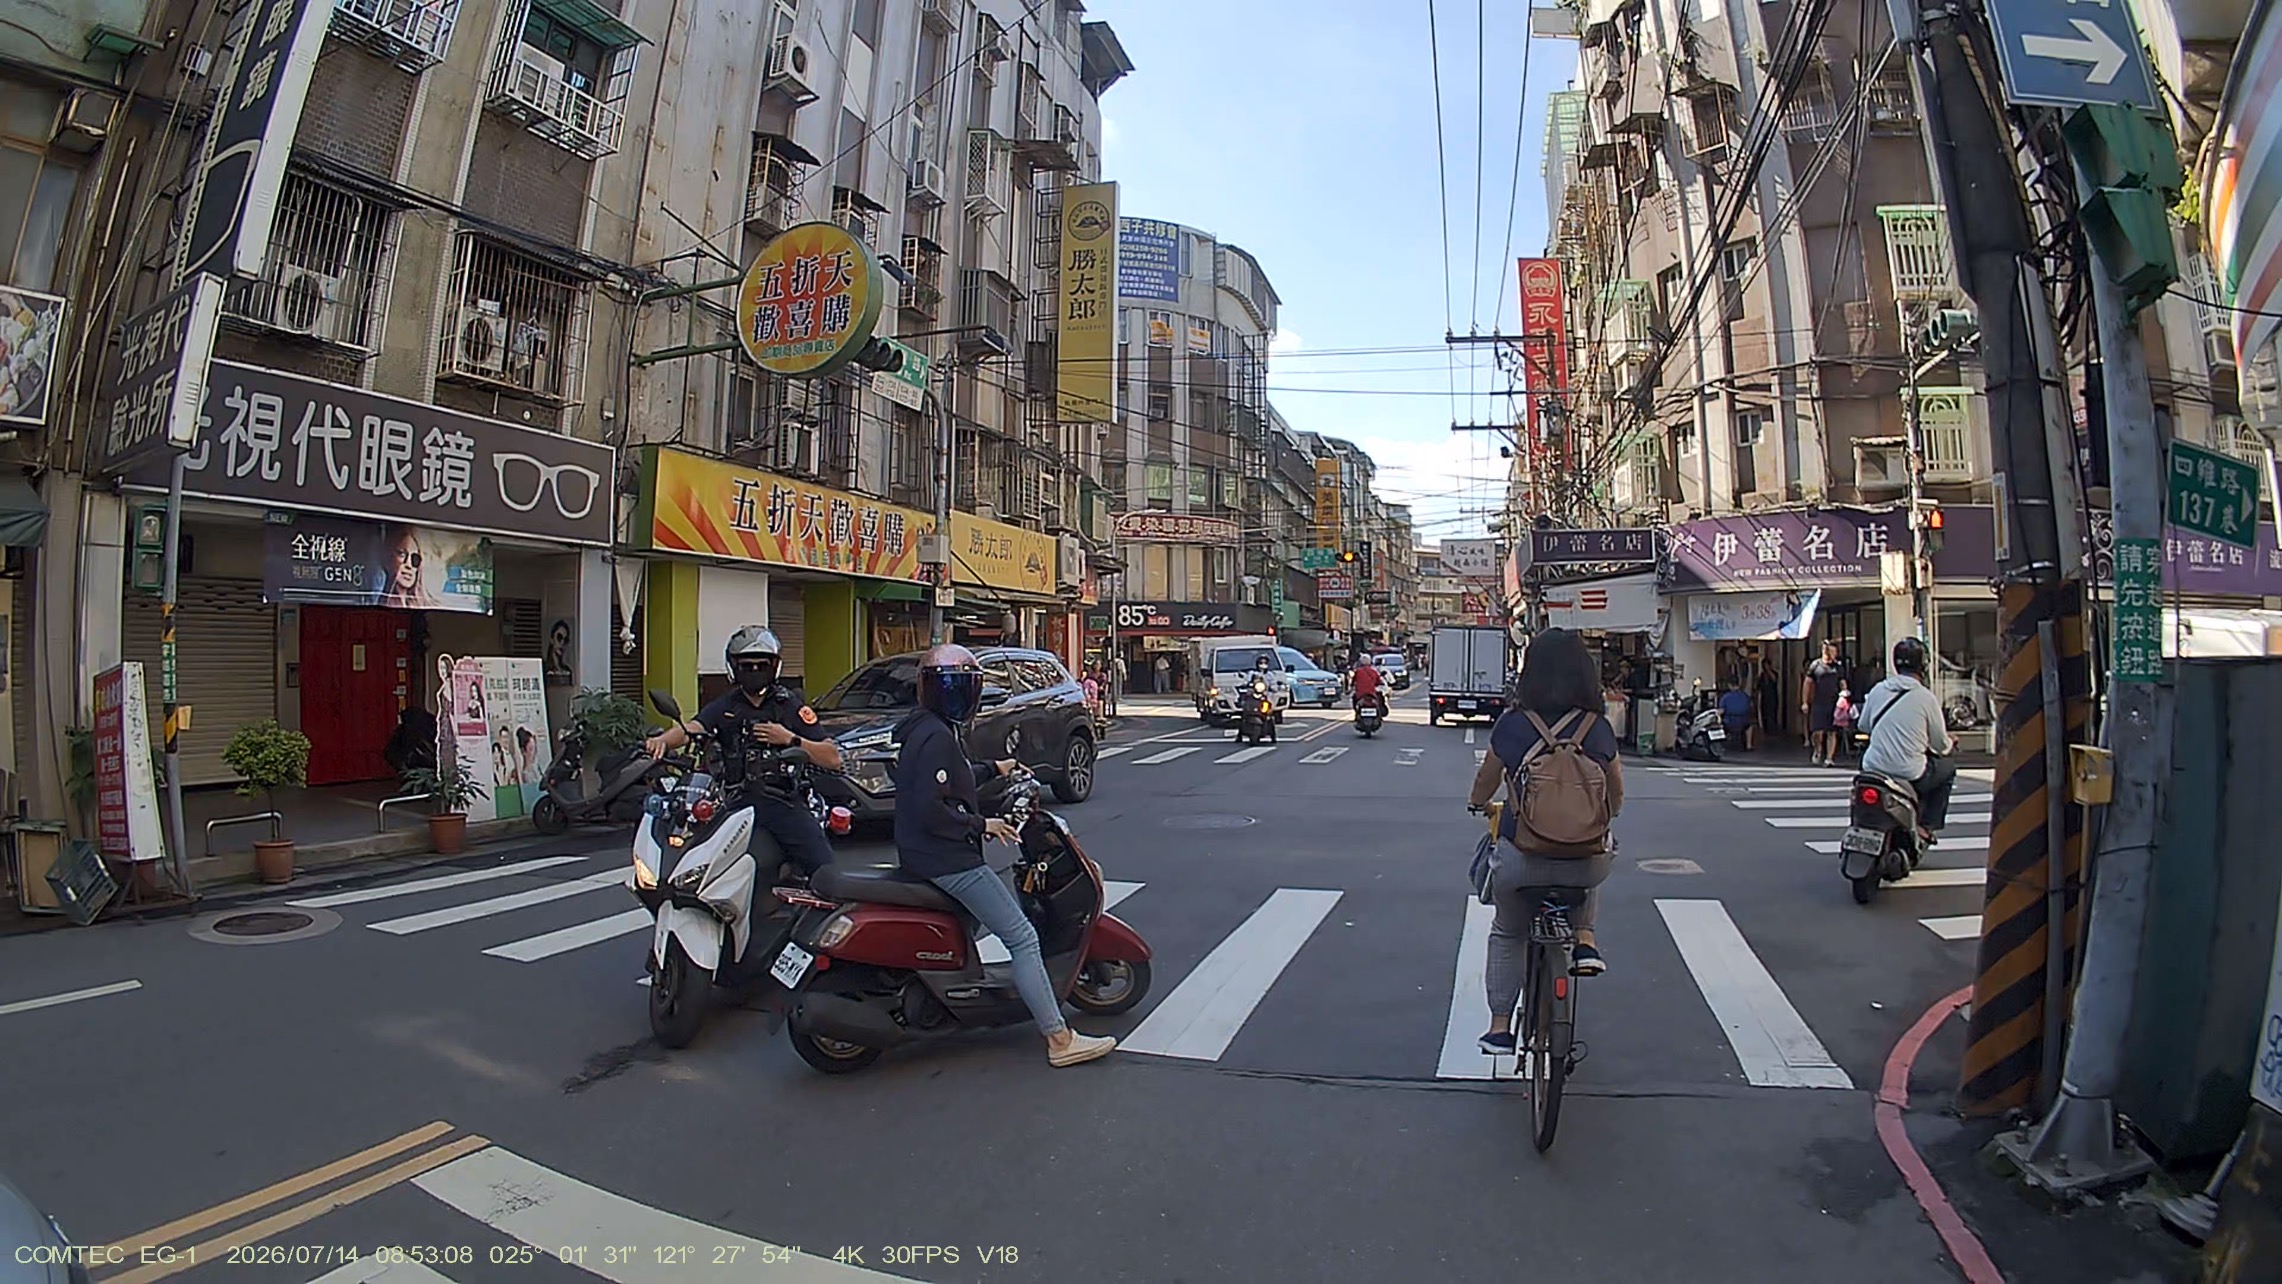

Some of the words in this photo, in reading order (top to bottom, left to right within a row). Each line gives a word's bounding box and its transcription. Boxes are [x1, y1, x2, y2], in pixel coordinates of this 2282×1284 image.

[756, 248, 854, 304] 五折天
[1068, 248, 1097, 321] 勝太郎
[116, 294, 190, 386] 光視代
[753, 294, 852, 344] 歡喜購
[2174, 454, 2241, 496] 四維路
[729, 476, 905, 558] 五折天歡喜購
[969, 527, 1013, 561] 勝太郎
[1713, 522, 1890, 567] 伊蕾名店
[2165, 538, 2244, 565] 伊蕾名店
[1755, 566, 1796, 576] FASHION
[1799, 564, 1862, 575] COLLECTION
[2119, 544, 2145, 675] 請先按鈕
